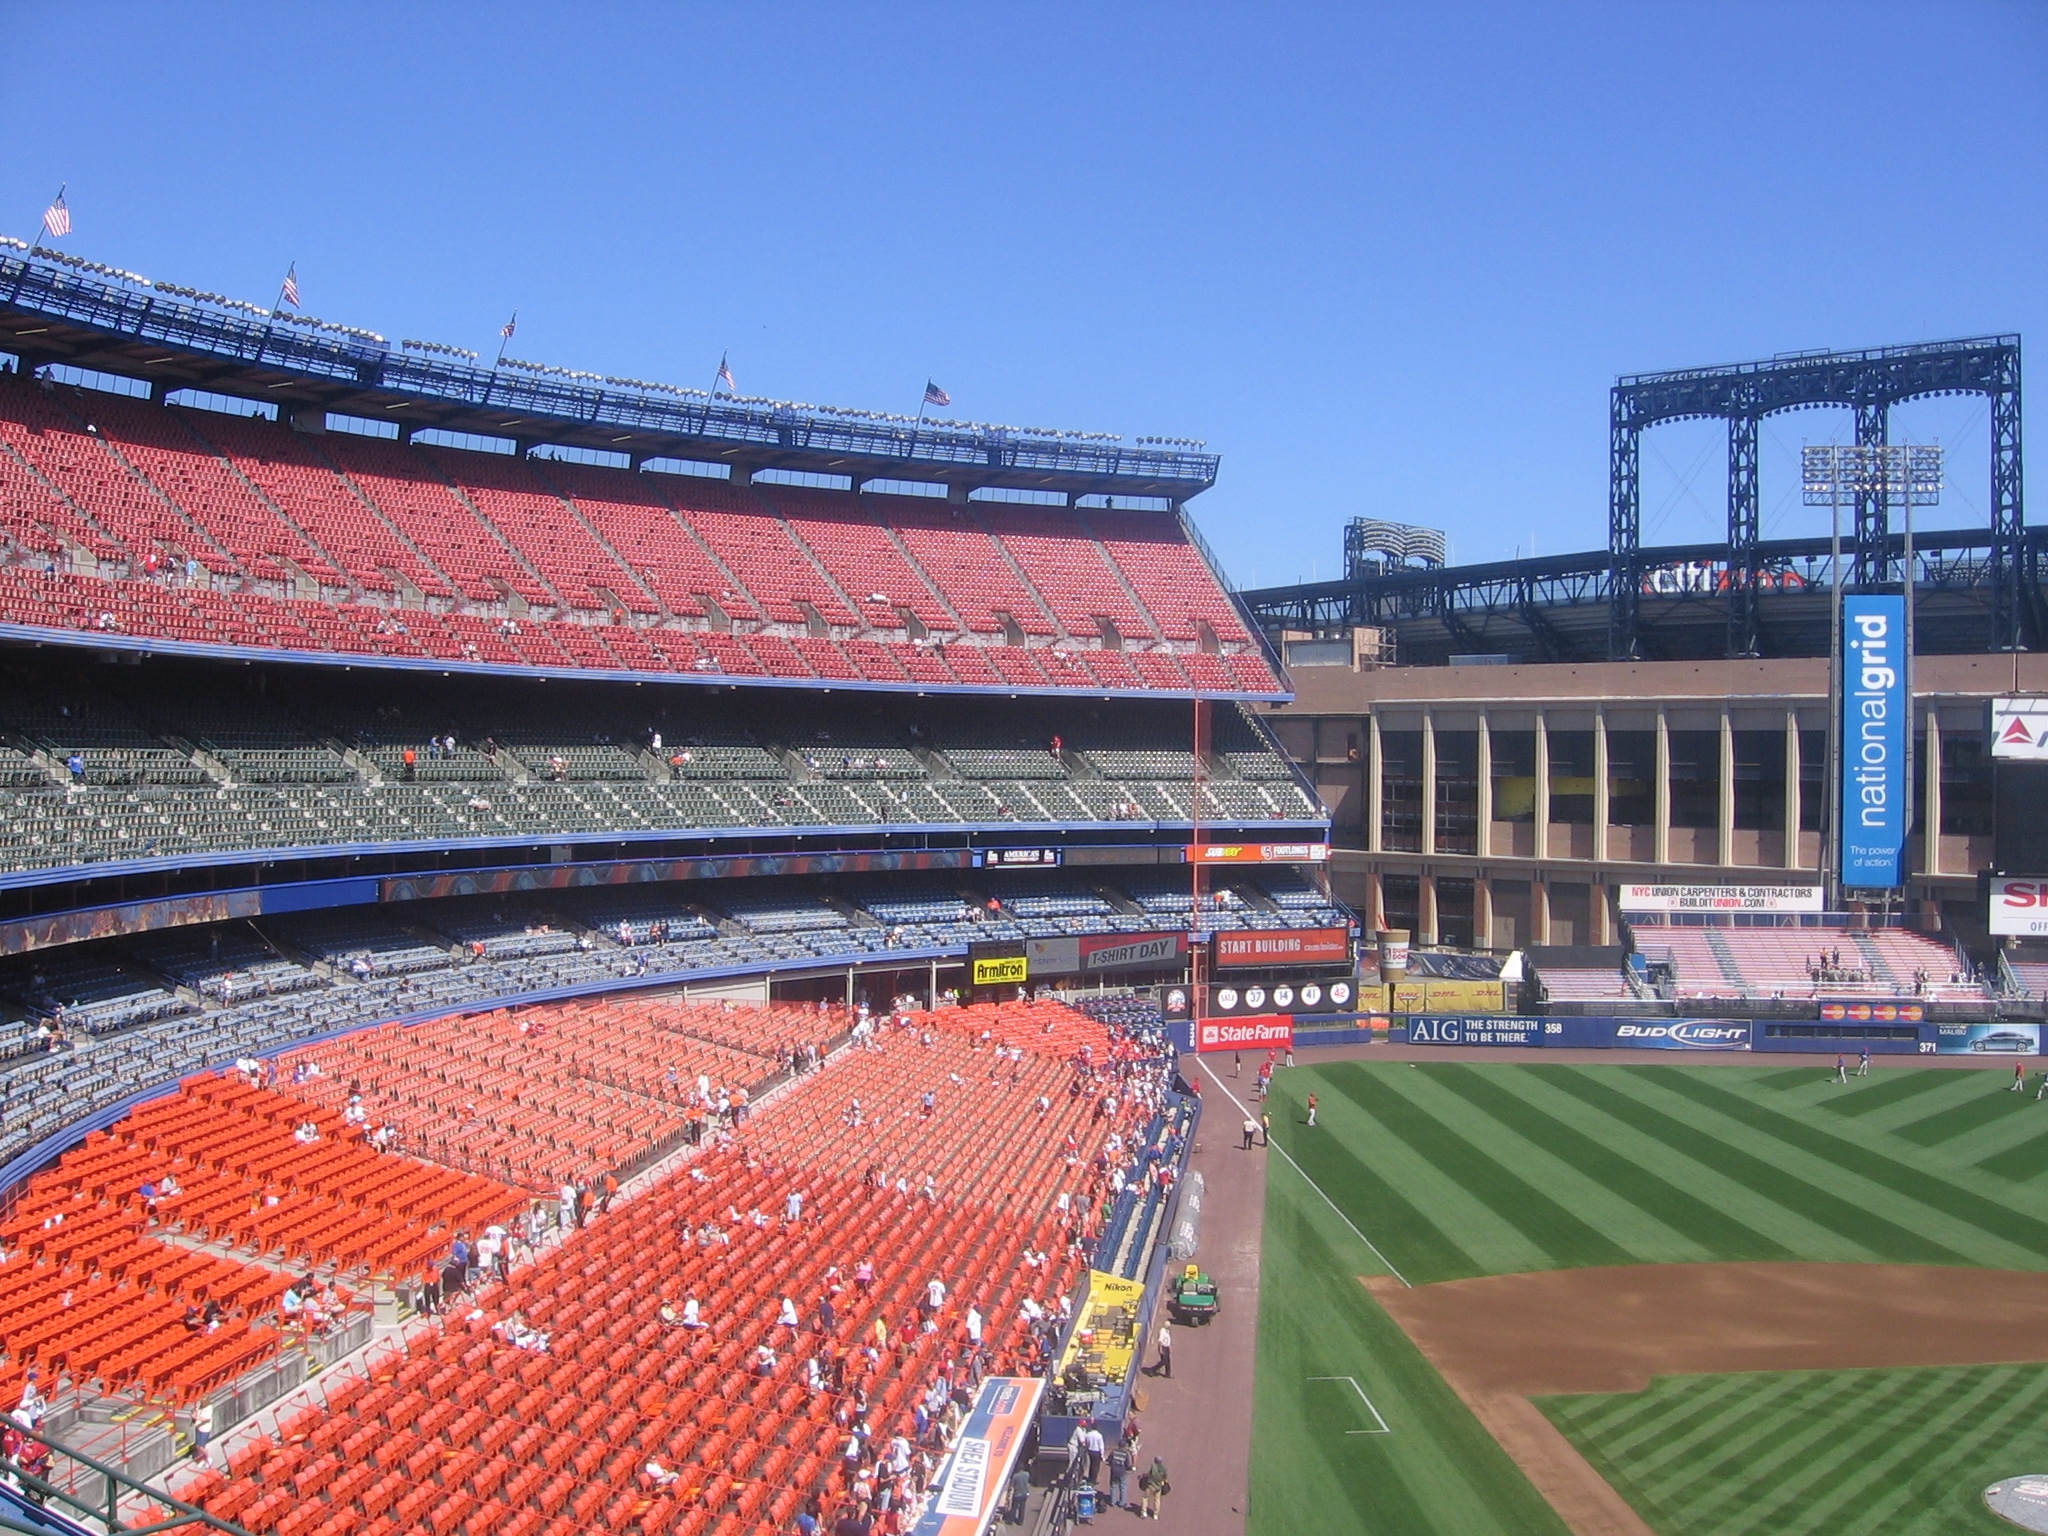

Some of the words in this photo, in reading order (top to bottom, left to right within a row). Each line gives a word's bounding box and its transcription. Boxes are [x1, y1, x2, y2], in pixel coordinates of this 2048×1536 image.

[1850, 614, 1895, 826] nationalgrid
[1850, 846, 1867, 855] The
[1869, 848, 1896, 856] power
[1854, 858, 1863, 867] of
[1632, 887, 1651, 897] NYC
[1652, 887, 1680, 897] UNION
[1681, 887, 1738, 898] CARPENTERS
[1739, 888, 1747, 897] &
[1748, 888, 1812, 898] CONTRACTORS
[1092, 946, 1137, 963] T-SHIRT
[1139, 940, 1169, 957] DAY
[1220, 940, 1252, 954] START
[1255, 938, 1301, 953] BUILDING
[977, 963, 1023, 977] Armitron
[1250, 993, 1262, 1003] 37
[1279, 990, 1289, 1001] 14
[1306, 989, 1316, 1000] 41
[1335, 988, 1345, 999] 42
[1412, 1020, 1459, 1041] AIG
[1465, 1019, 1484, 1030] THE
[1486, 1020, 1538, 1031] STRENGTH
[1544, 1023, 1563, 1034] 358
[1466, 1032, 1477, 1042] TO
[1480, 1032, 1493, 1042] BE
[1939, 1028, 1967, 1036] MALIBU
[1919, 1042, 1937, 1053] 371
[1104, 1282, 1133, 1292] Nikon
[959, 1440, 986, 1465] SHEA
[945, 1466, 980, 1512] STADIUM
